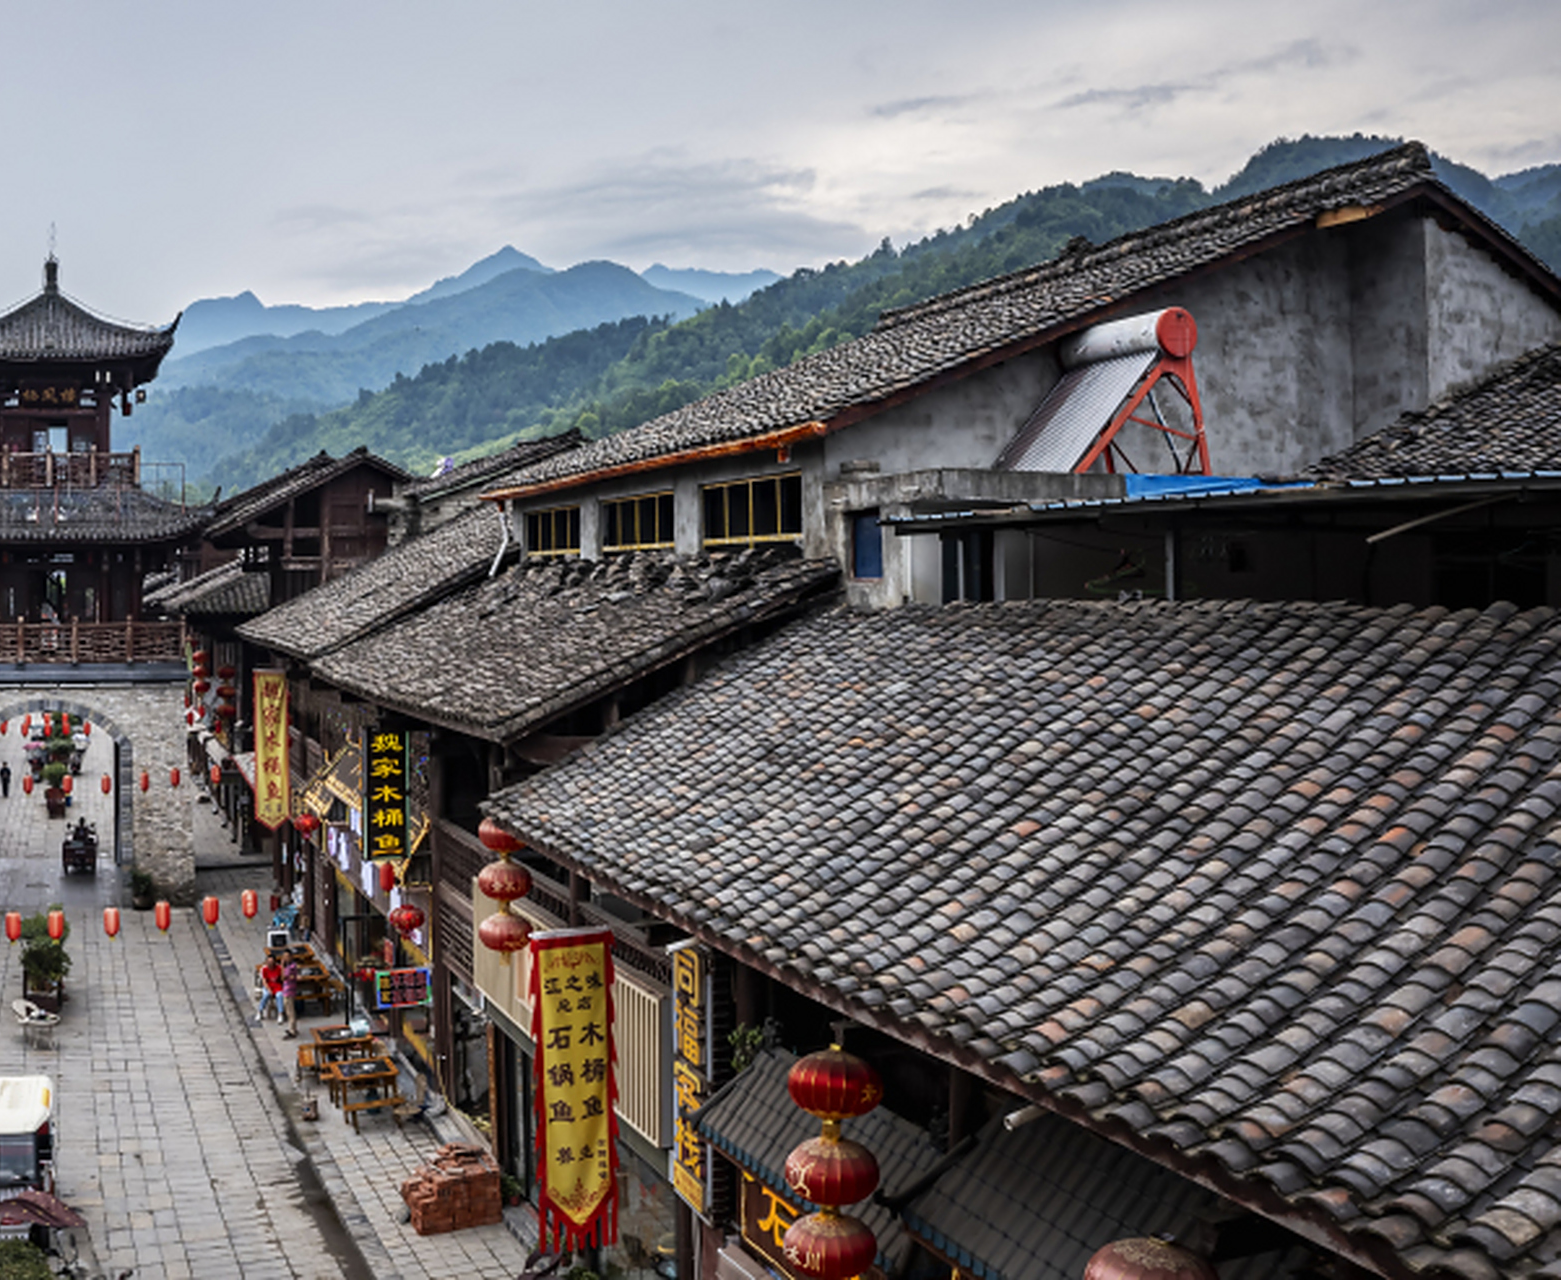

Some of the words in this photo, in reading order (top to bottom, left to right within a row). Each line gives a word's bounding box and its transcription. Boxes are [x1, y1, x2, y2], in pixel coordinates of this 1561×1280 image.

[371, 733, 403, 856] 魏家木桶鱼
